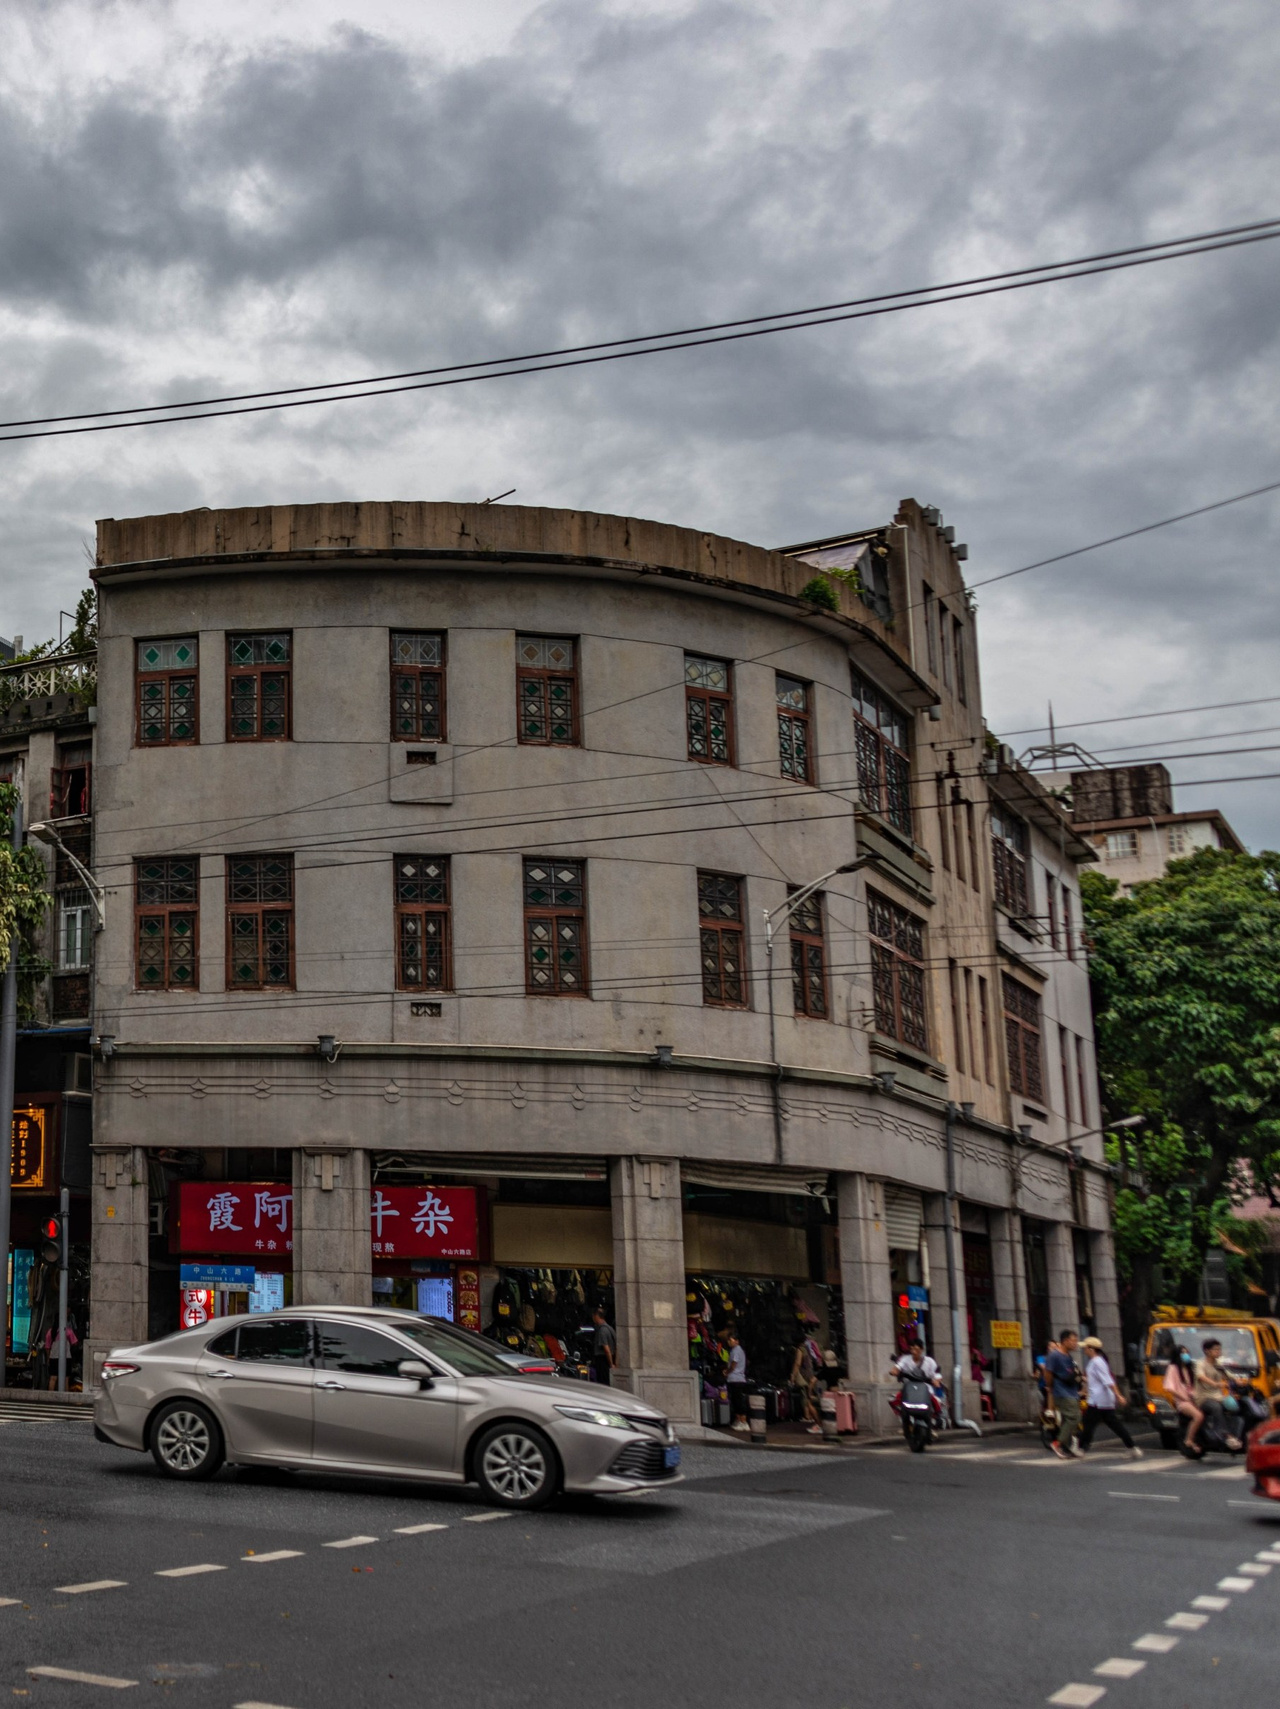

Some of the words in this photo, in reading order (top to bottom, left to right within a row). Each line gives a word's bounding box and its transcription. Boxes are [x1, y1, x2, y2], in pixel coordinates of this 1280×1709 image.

[255, 1239, 277, 1250] 牛杂
[193, 1266, 242, 1276] 中山六路
